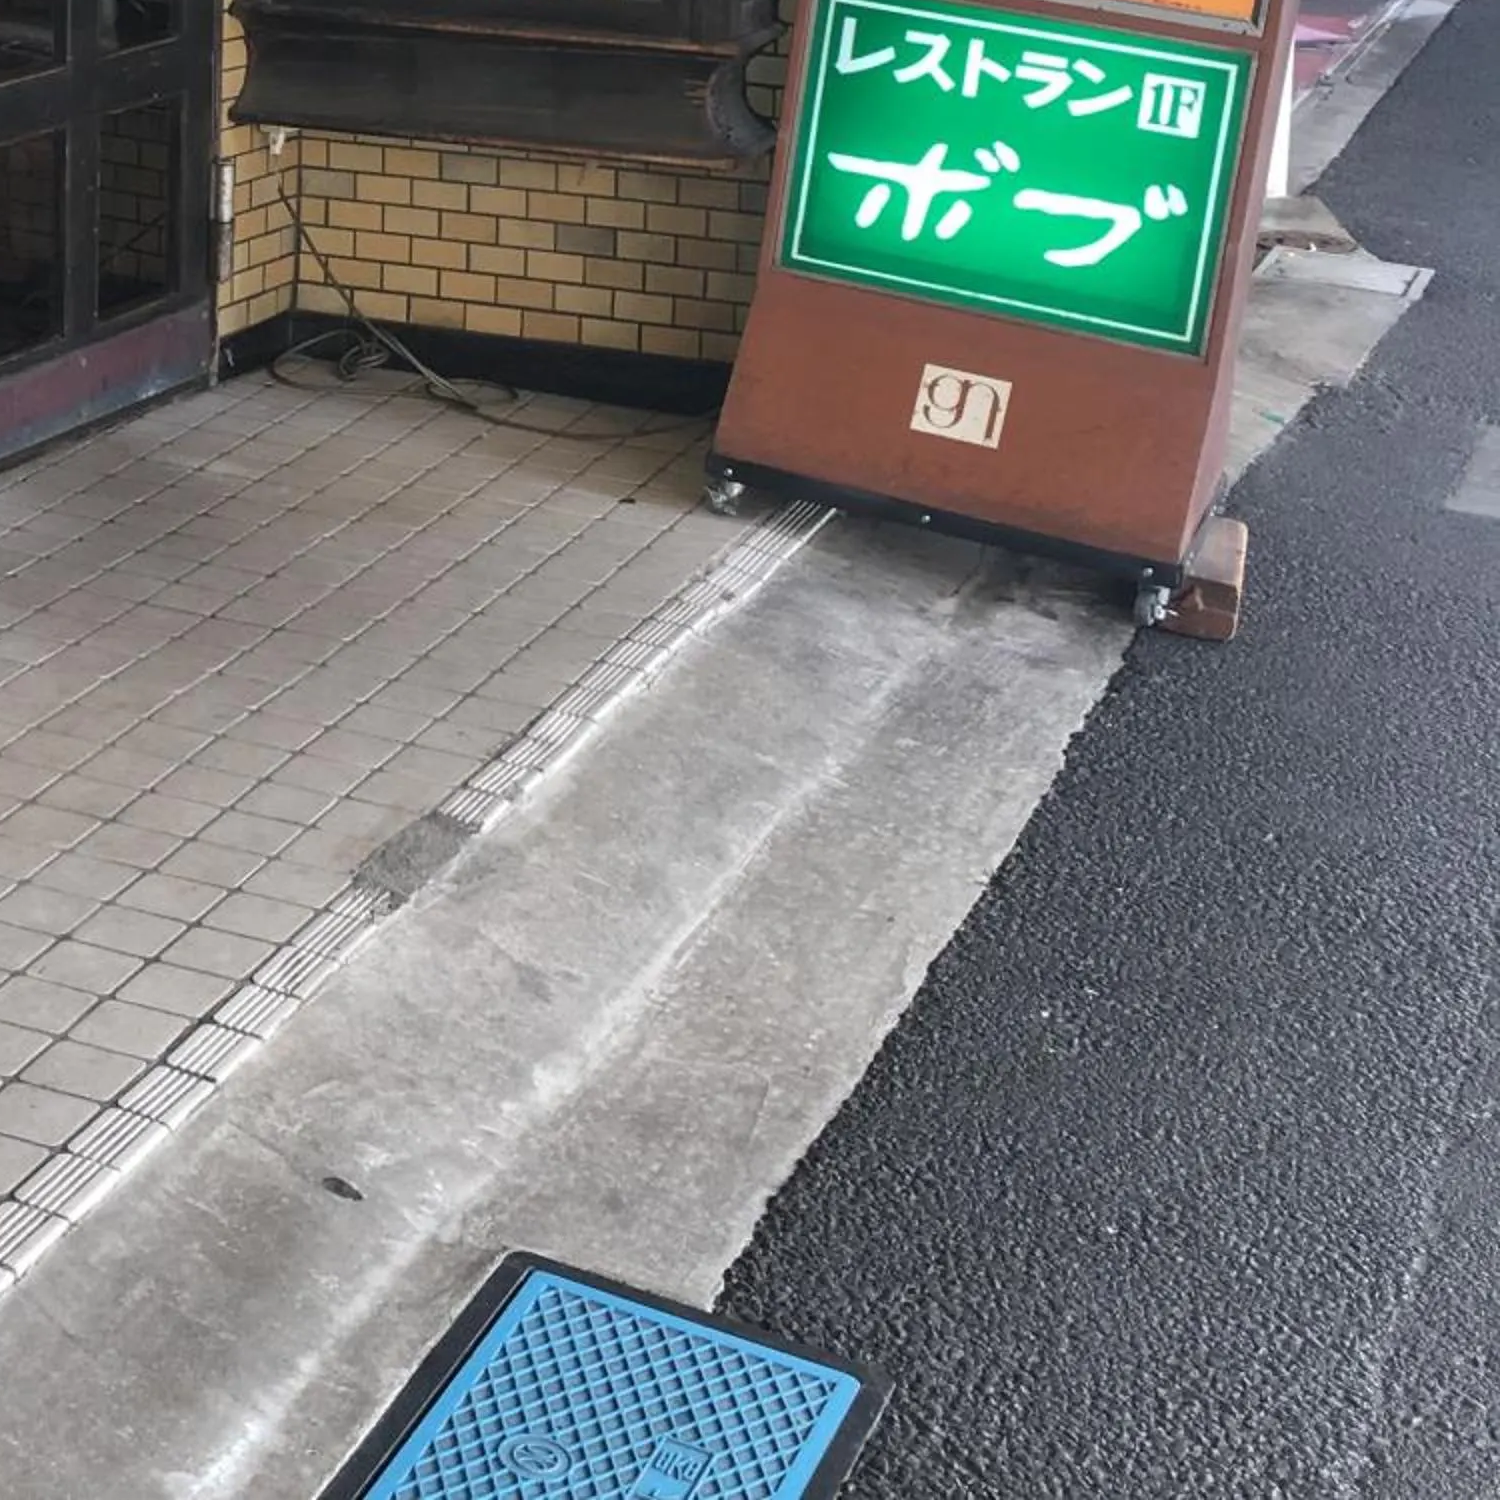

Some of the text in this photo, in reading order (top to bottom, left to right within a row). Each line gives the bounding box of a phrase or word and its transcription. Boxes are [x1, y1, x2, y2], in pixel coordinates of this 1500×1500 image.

[835, 16, 1134, 117] レストラン
[827, 140, 1189, 268] ボブ
